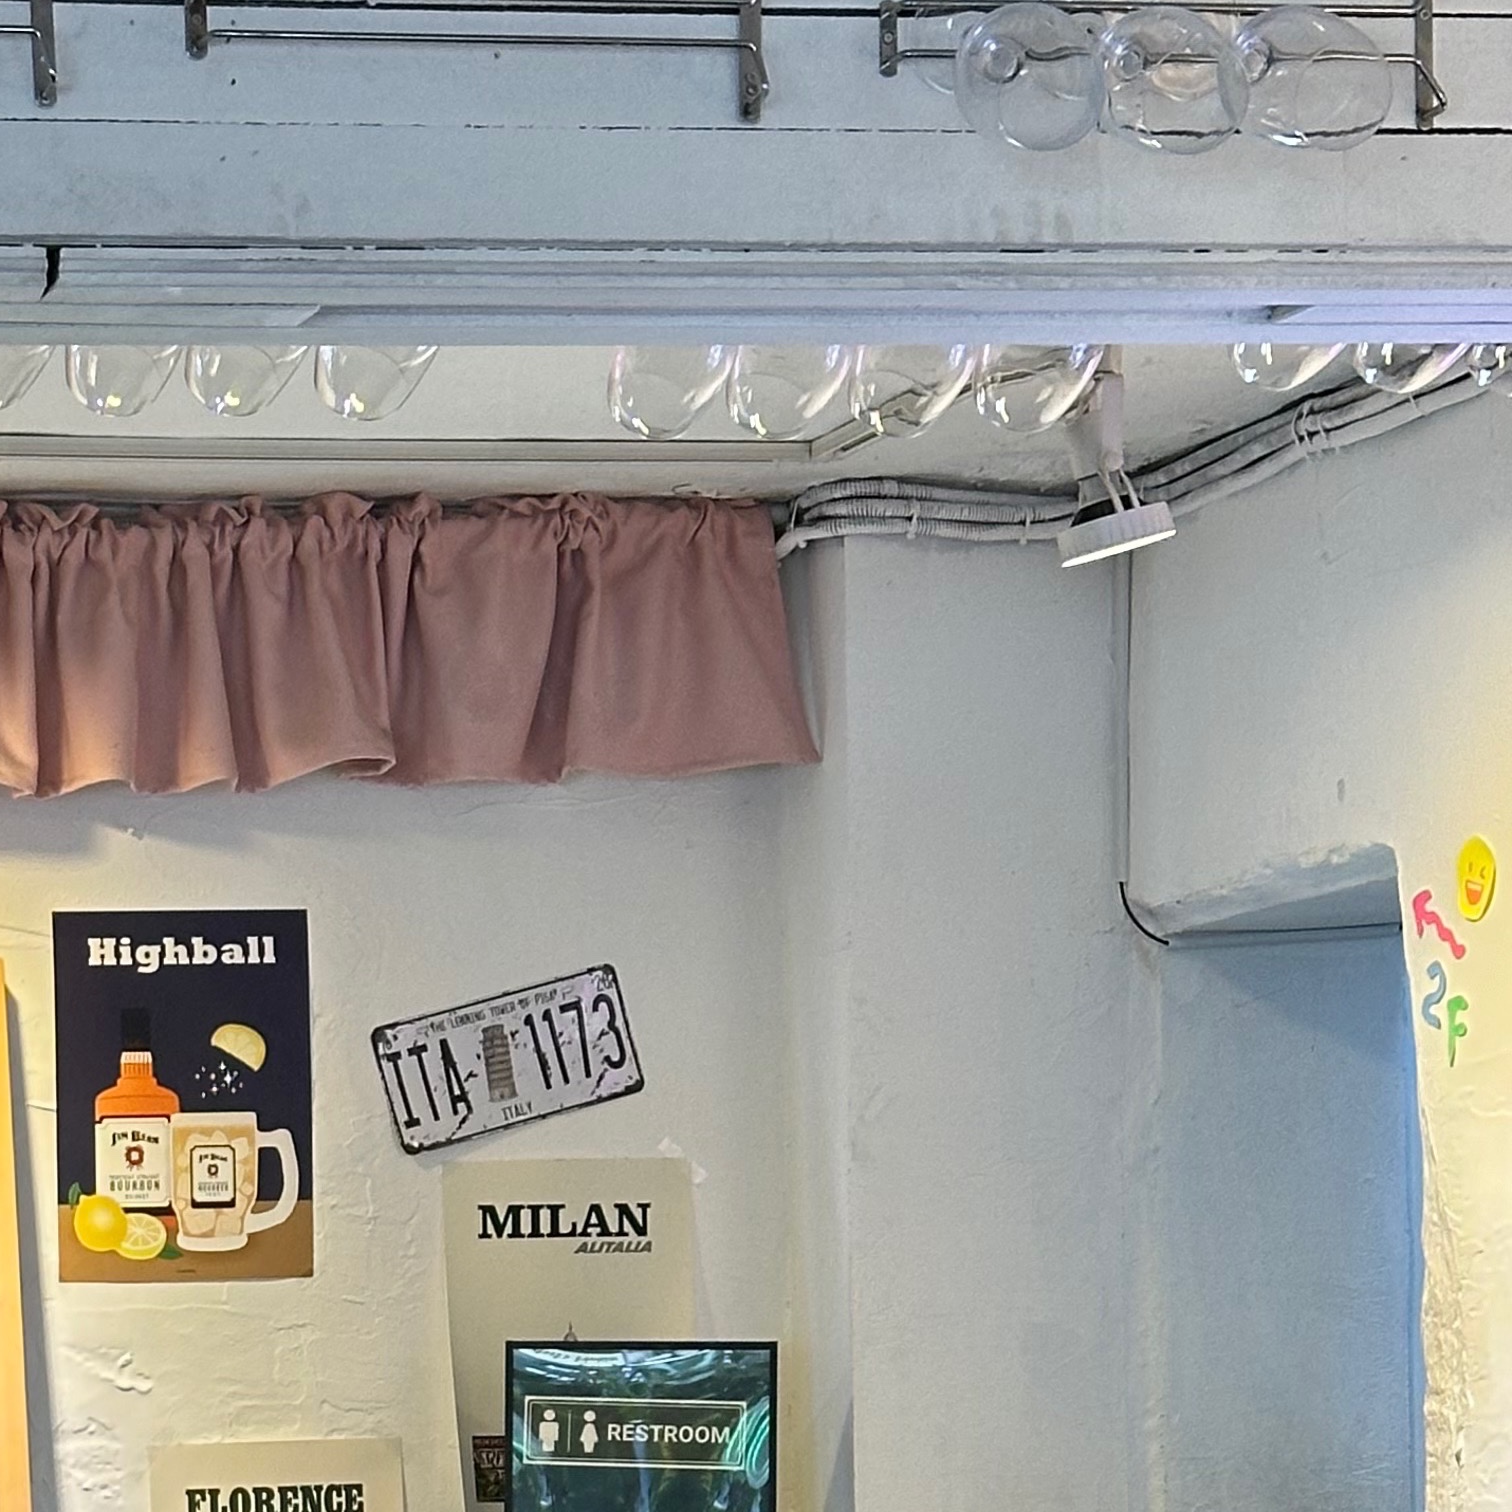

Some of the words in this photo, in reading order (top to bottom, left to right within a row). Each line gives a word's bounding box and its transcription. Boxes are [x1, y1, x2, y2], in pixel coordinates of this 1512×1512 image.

[87, 935, 276, 973] Highball
[1421, 960, 1469, 1068] 2F
[383, 1037, 473, 1129] ITA
[523, 992, 628, 1091] 1173
[501, 1100, 533, 1122] ITALY
[109, 1179, 161, 1192] BOURBON
[477, 1201, 652, 1240] MILAN
[573, 1239, 653, 1254] ALITALIA
[606, 1422, 731, 1446] RESTROOM
